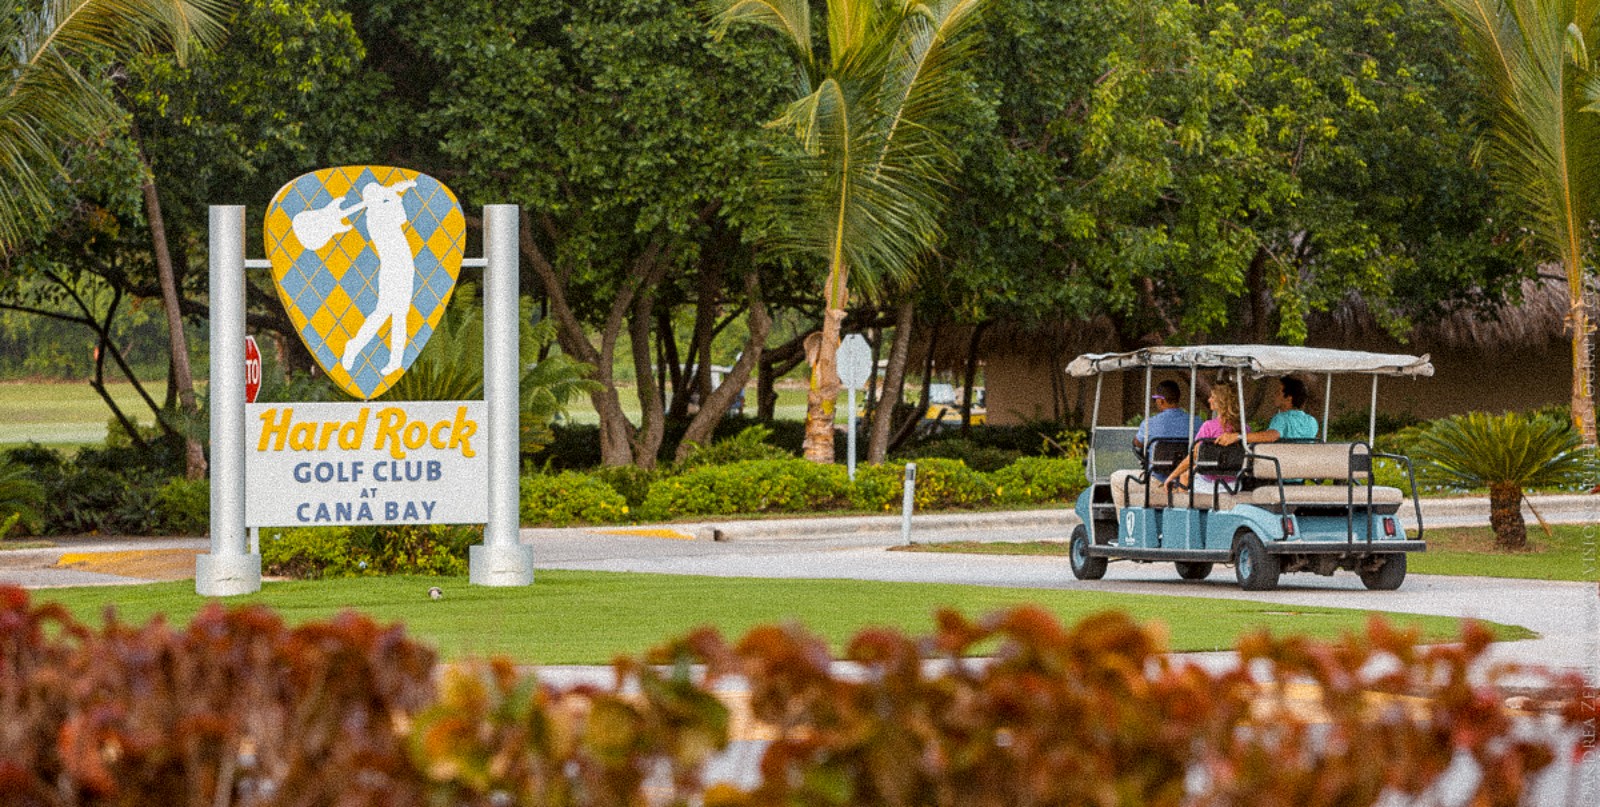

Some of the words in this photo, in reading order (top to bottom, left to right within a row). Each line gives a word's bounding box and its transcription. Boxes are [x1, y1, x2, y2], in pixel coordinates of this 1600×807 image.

[245, 359, 259, 385] TO
[257, 407, 370, 452] Hard
[374, 406, 478, 459] Rock
[293, 461, 363, 483] GOLF
[373, 460, 442, 482] CLUB
[360, 487, 377, 499] AT
[297, 502, 374, 522] CANA
[385, 501, 437, 521] BAY
